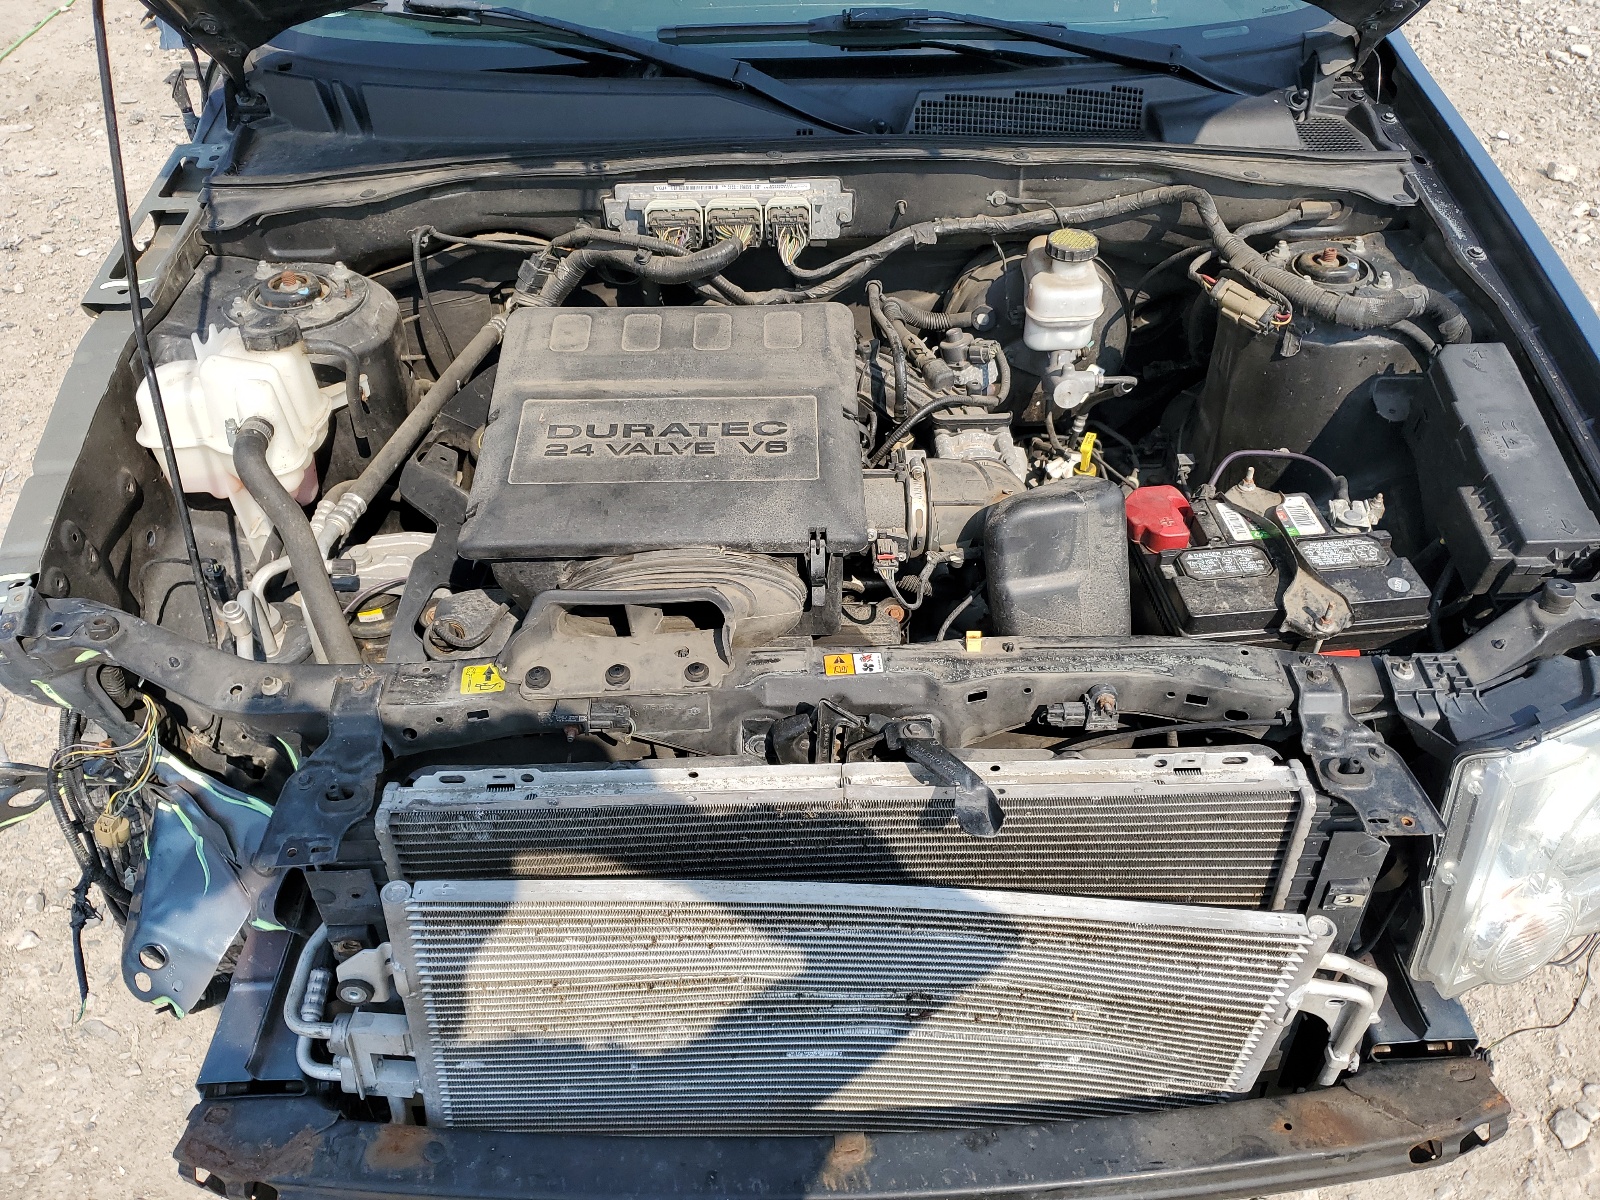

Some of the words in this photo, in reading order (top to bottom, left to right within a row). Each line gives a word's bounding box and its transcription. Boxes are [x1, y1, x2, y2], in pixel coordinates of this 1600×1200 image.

[546, 420, 788, 439] DURATEC
[544, 443, 595, 457] 24
[605, 441, 716, 456] VALVE
[739, 440, 788, 454] V6
